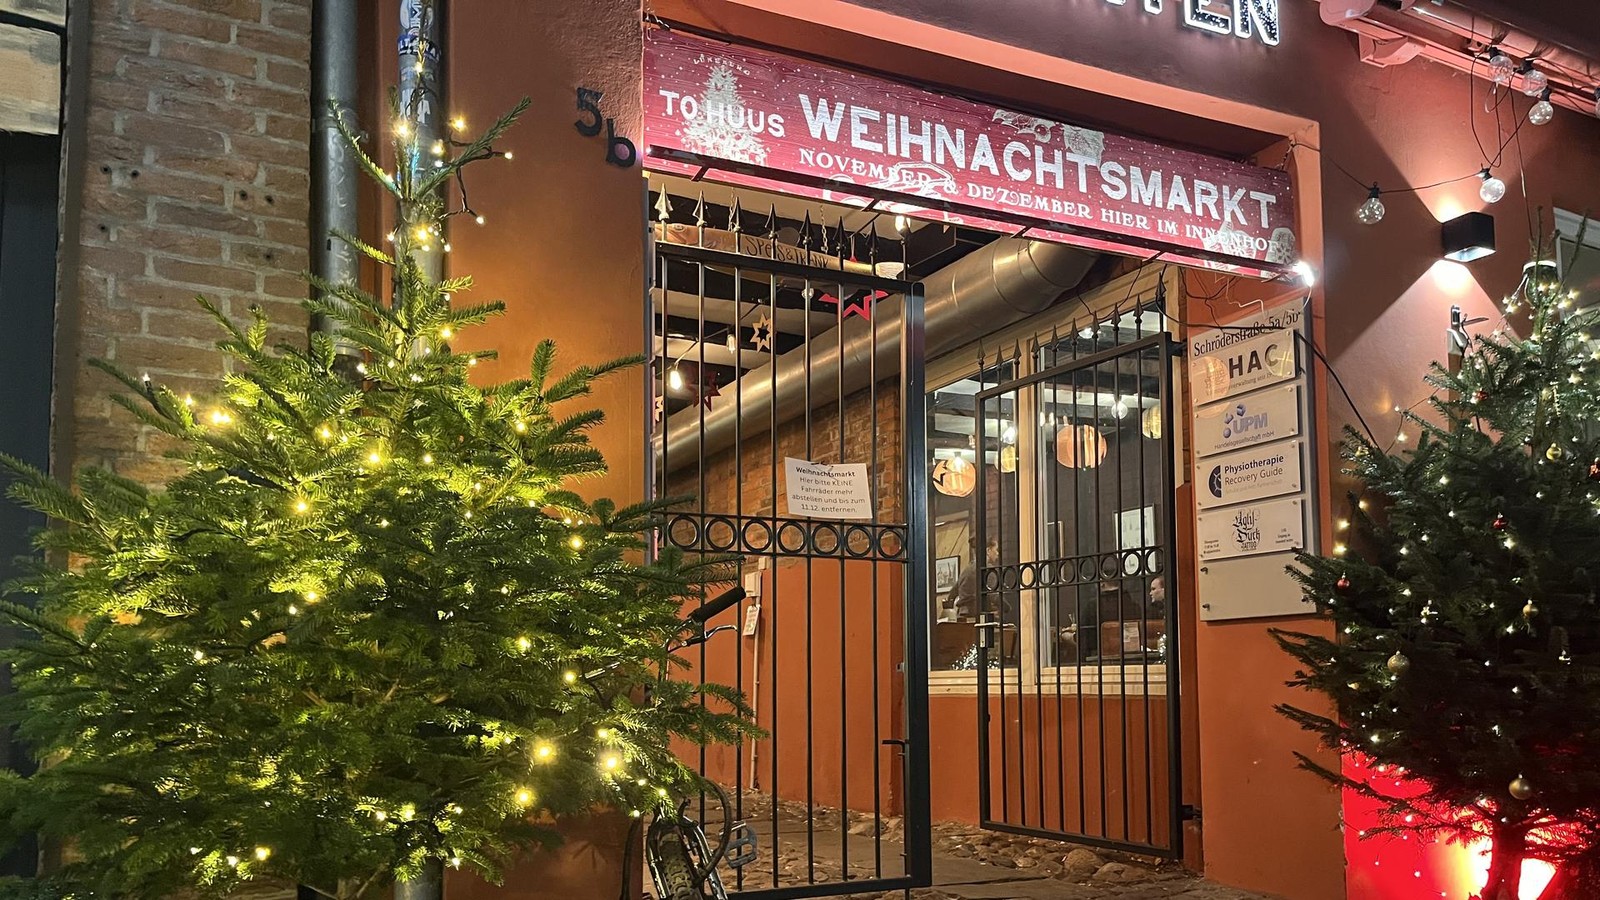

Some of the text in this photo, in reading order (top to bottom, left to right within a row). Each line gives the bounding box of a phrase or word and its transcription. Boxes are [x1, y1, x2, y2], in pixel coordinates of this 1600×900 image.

[659, 89, 786, 138] TO HUUS
[799, 93, 1277, 229] WEIHNACHTSMARKT
[798, 147, 1278, 253] NOVEMBER & DEZEMBER HIER IM INNENHOF
[1194, 322, 1265, 357] Schröderstraße
[1229, 343, 1279, 379] HAC
[1233, 412, 1268, 434] UPM
[1262, 431, 1275, 439] mbH
[796, 467, 856, 478] Weihnachtsmarkt
[1224, 454, 1284, 475] Physiotherapie
[815, 478, 831, 486] bitte
[1225, 466, 1283, 486] Recovery Guide
[792, 494, 823, 503] abstellen
[801, 486, 834, 495] Fahrräder
